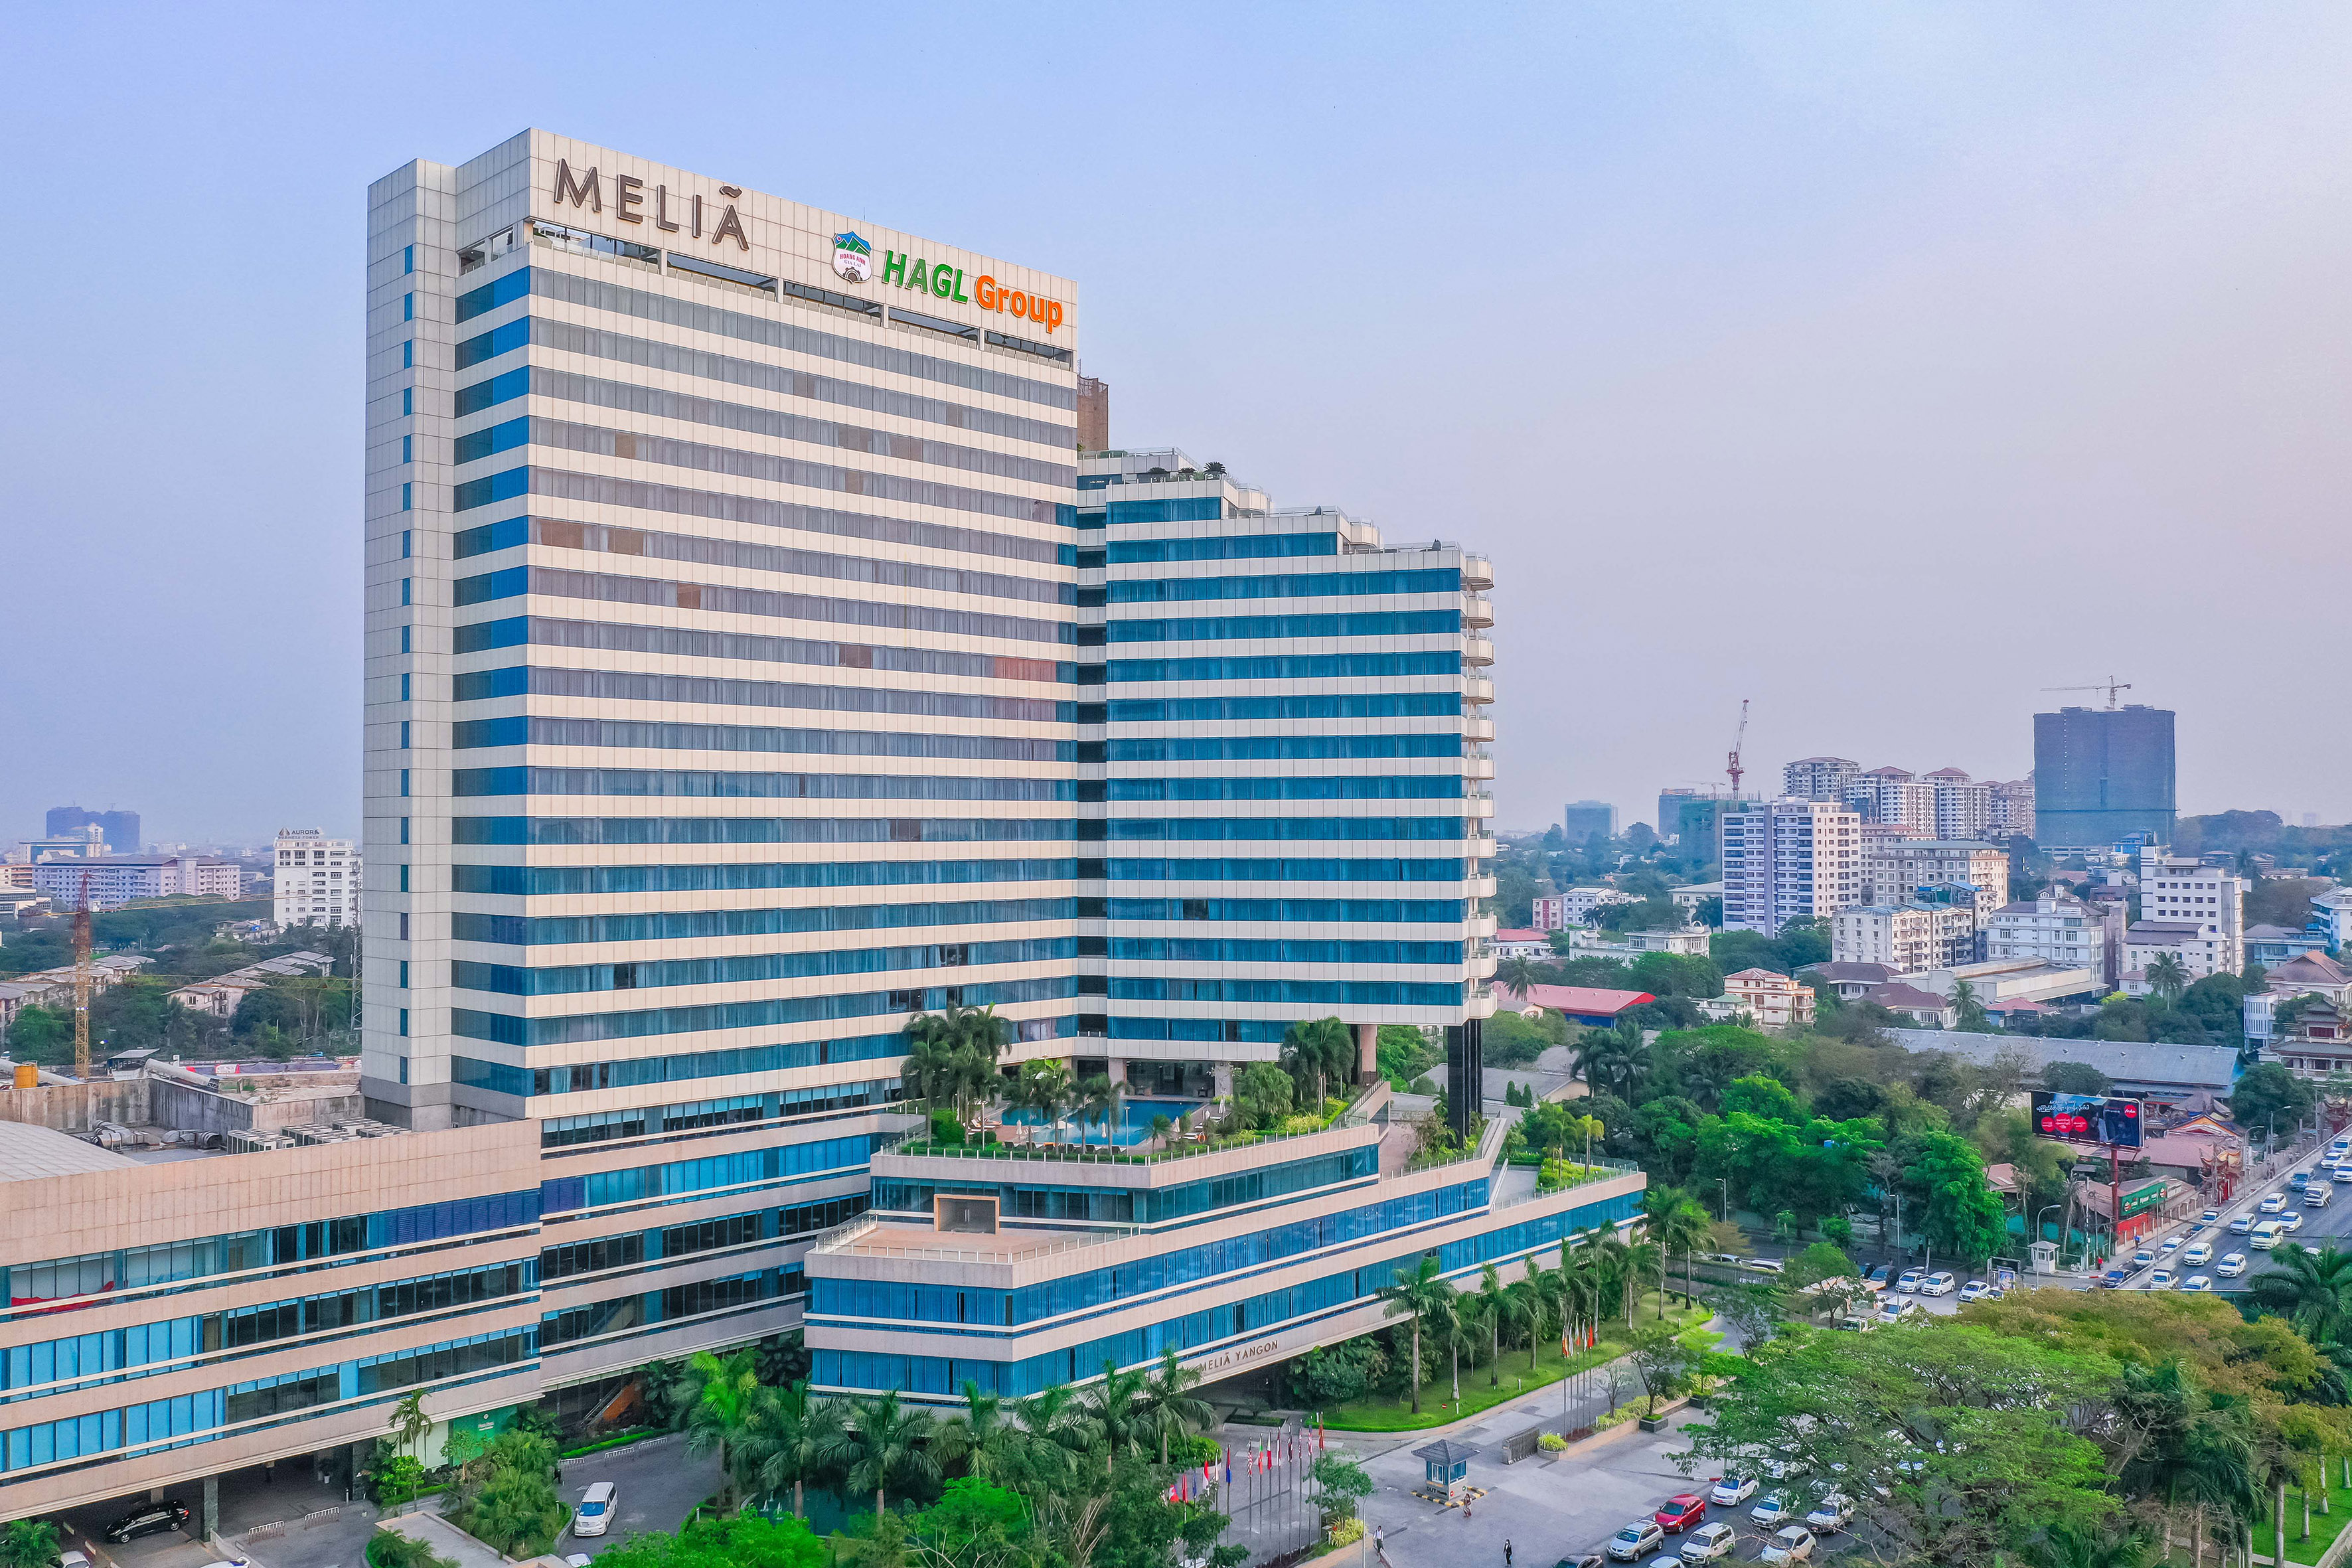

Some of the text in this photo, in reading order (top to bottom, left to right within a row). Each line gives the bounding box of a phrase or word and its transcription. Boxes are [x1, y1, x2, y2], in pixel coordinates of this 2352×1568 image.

[554, 158, 749, 251] MELIÃ
[856, 256, 866, 266] ANH
[882, 250, 1063, 333] HAGL Group
[1235, 1340, 1278, 1360] YANGON
